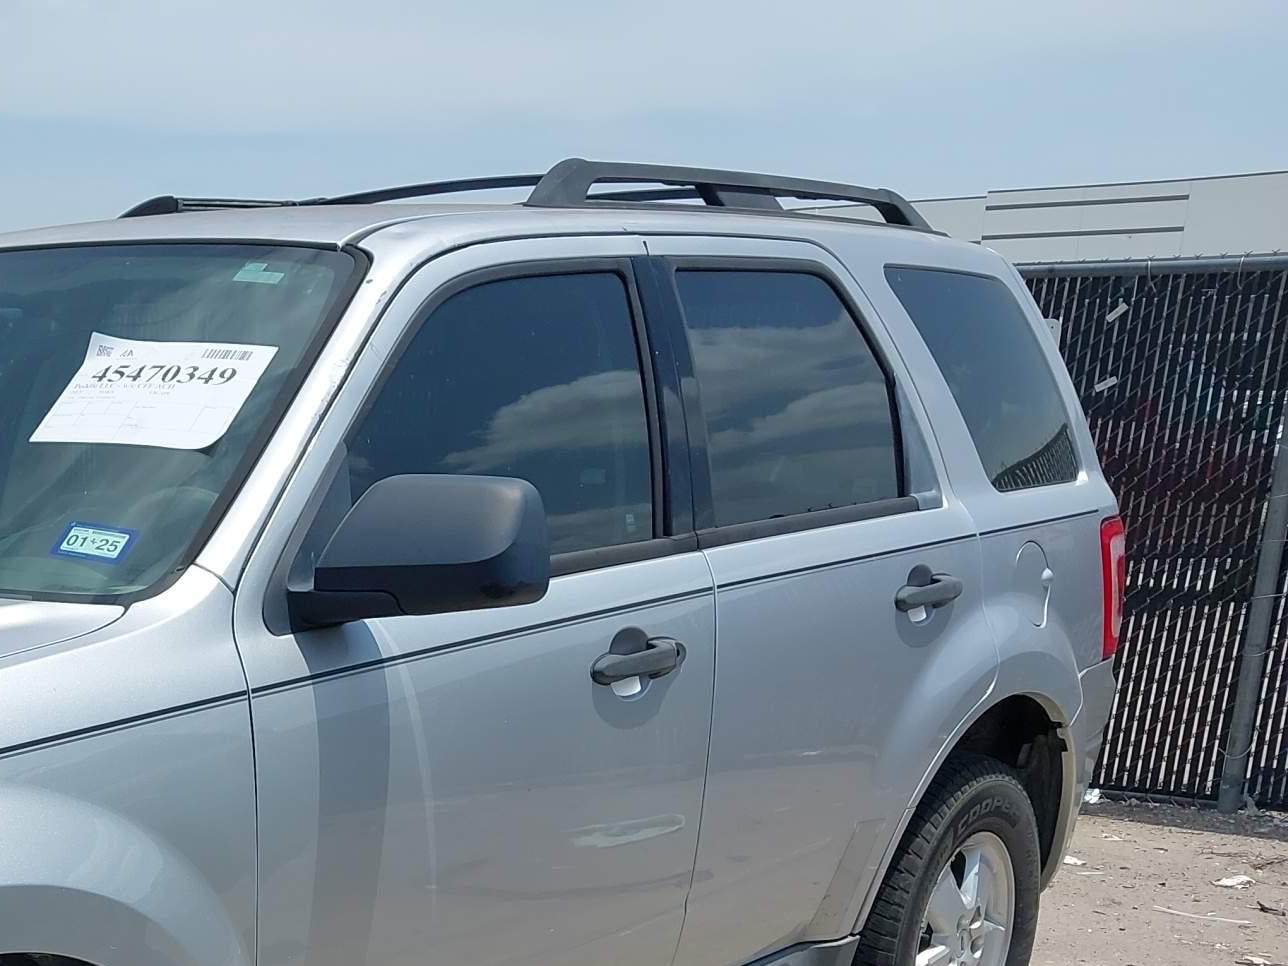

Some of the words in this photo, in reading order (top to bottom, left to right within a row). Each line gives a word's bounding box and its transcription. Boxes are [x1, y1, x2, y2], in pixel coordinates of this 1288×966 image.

[91, 364, 238, 386] 45470349
[66, 534, 89, 548] 01
[94, 538, 121, 553] 25
